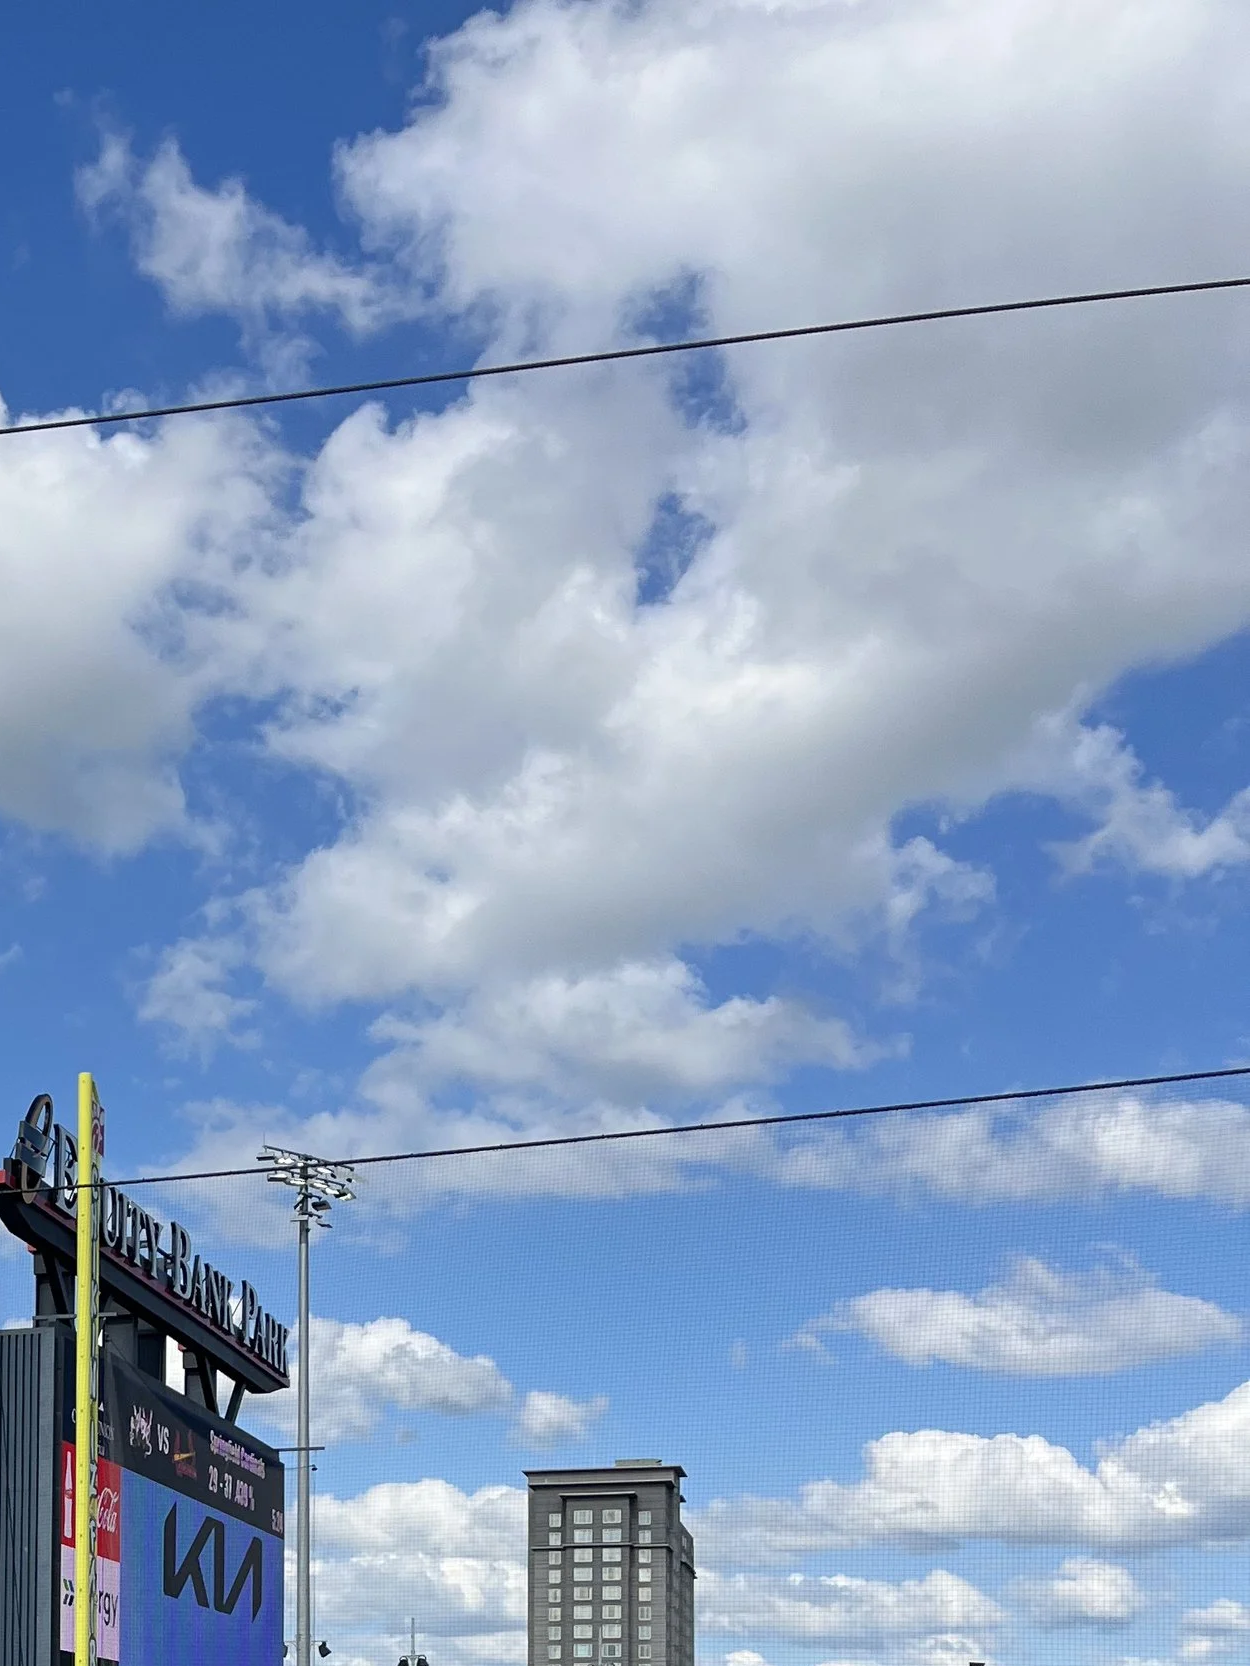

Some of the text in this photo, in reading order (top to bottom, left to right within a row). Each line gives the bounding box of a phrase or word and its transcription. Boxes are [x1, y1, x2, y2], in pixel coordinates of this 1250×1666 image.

[53, 1123, 290, 1378] EUITY BANK PARK
[157, 1423, 170, 1455] VS
[163, 1502, 263, 1623] KIA
